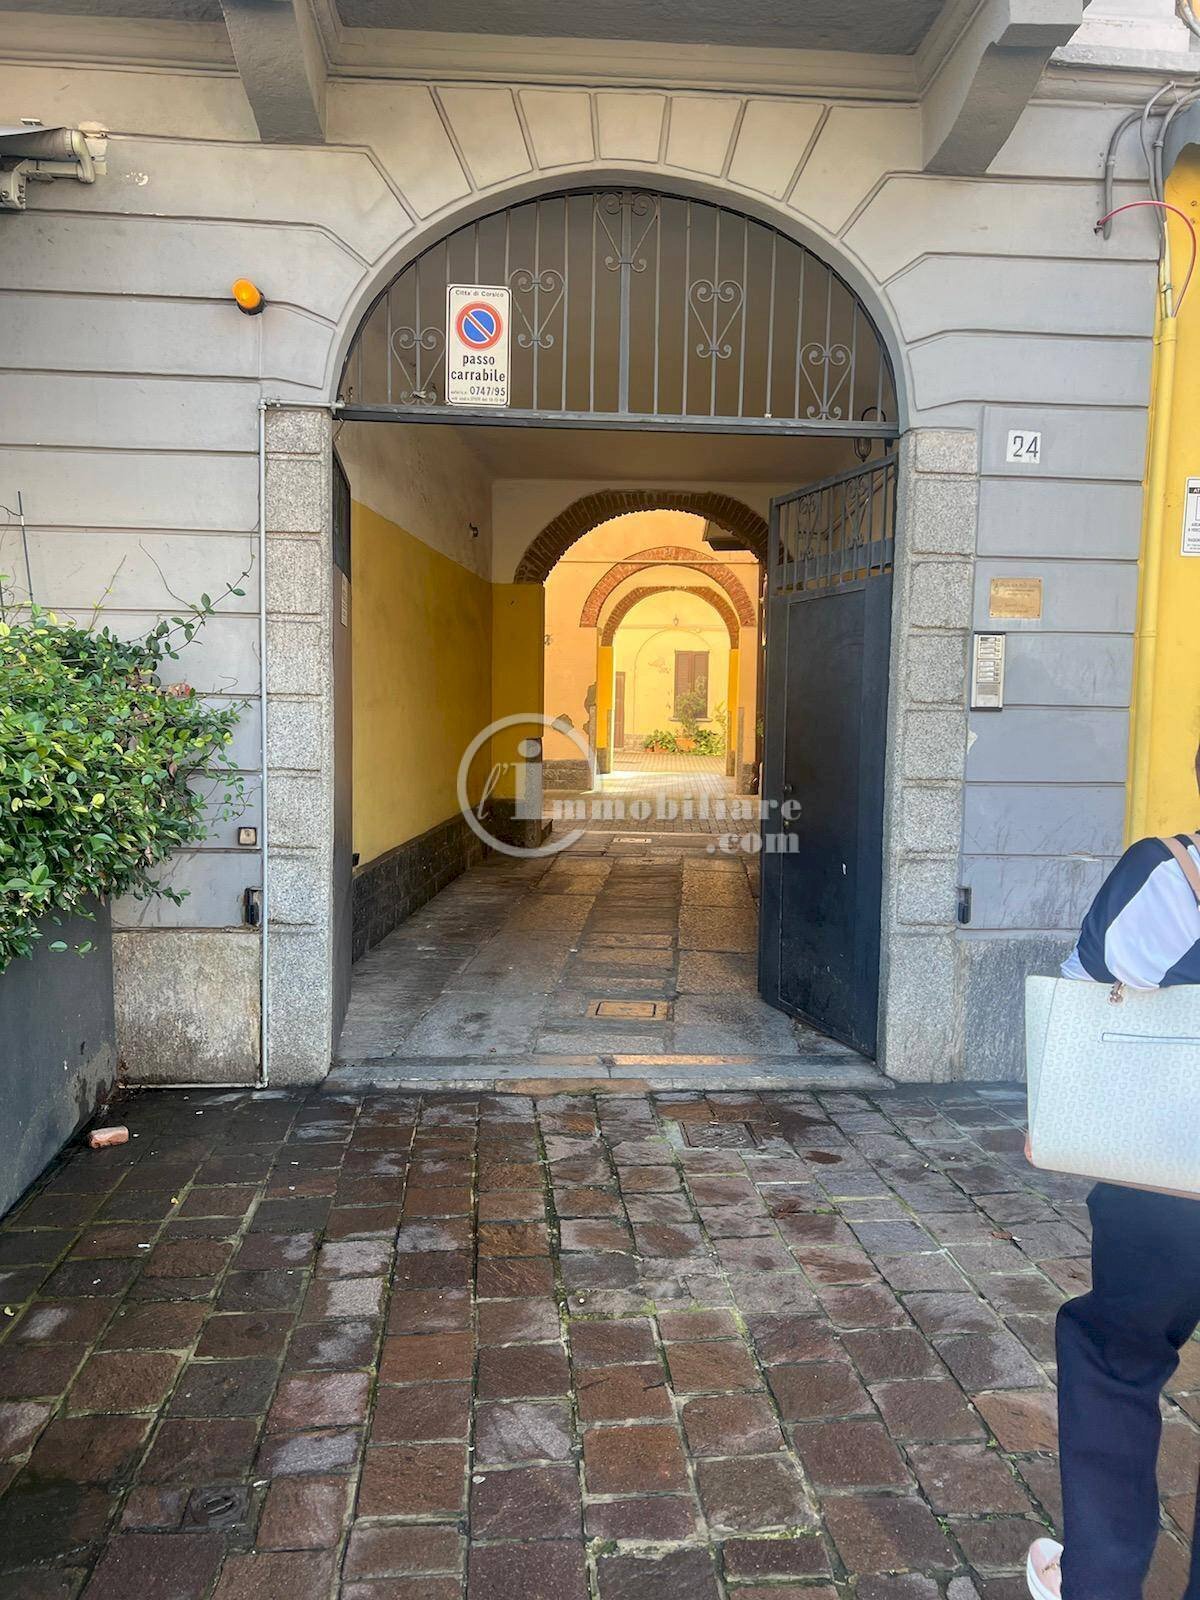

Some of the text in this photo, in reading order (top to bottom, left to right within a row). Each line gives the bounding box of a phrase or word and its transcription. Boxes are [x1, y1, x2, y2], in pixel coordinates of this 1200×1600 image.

[463, 355, 495, 367] passo
[451, 368, 506, 382] carrabile
[469, 386, 506, 397] 0747/95
[1013, 435, 1039, 458] 24
